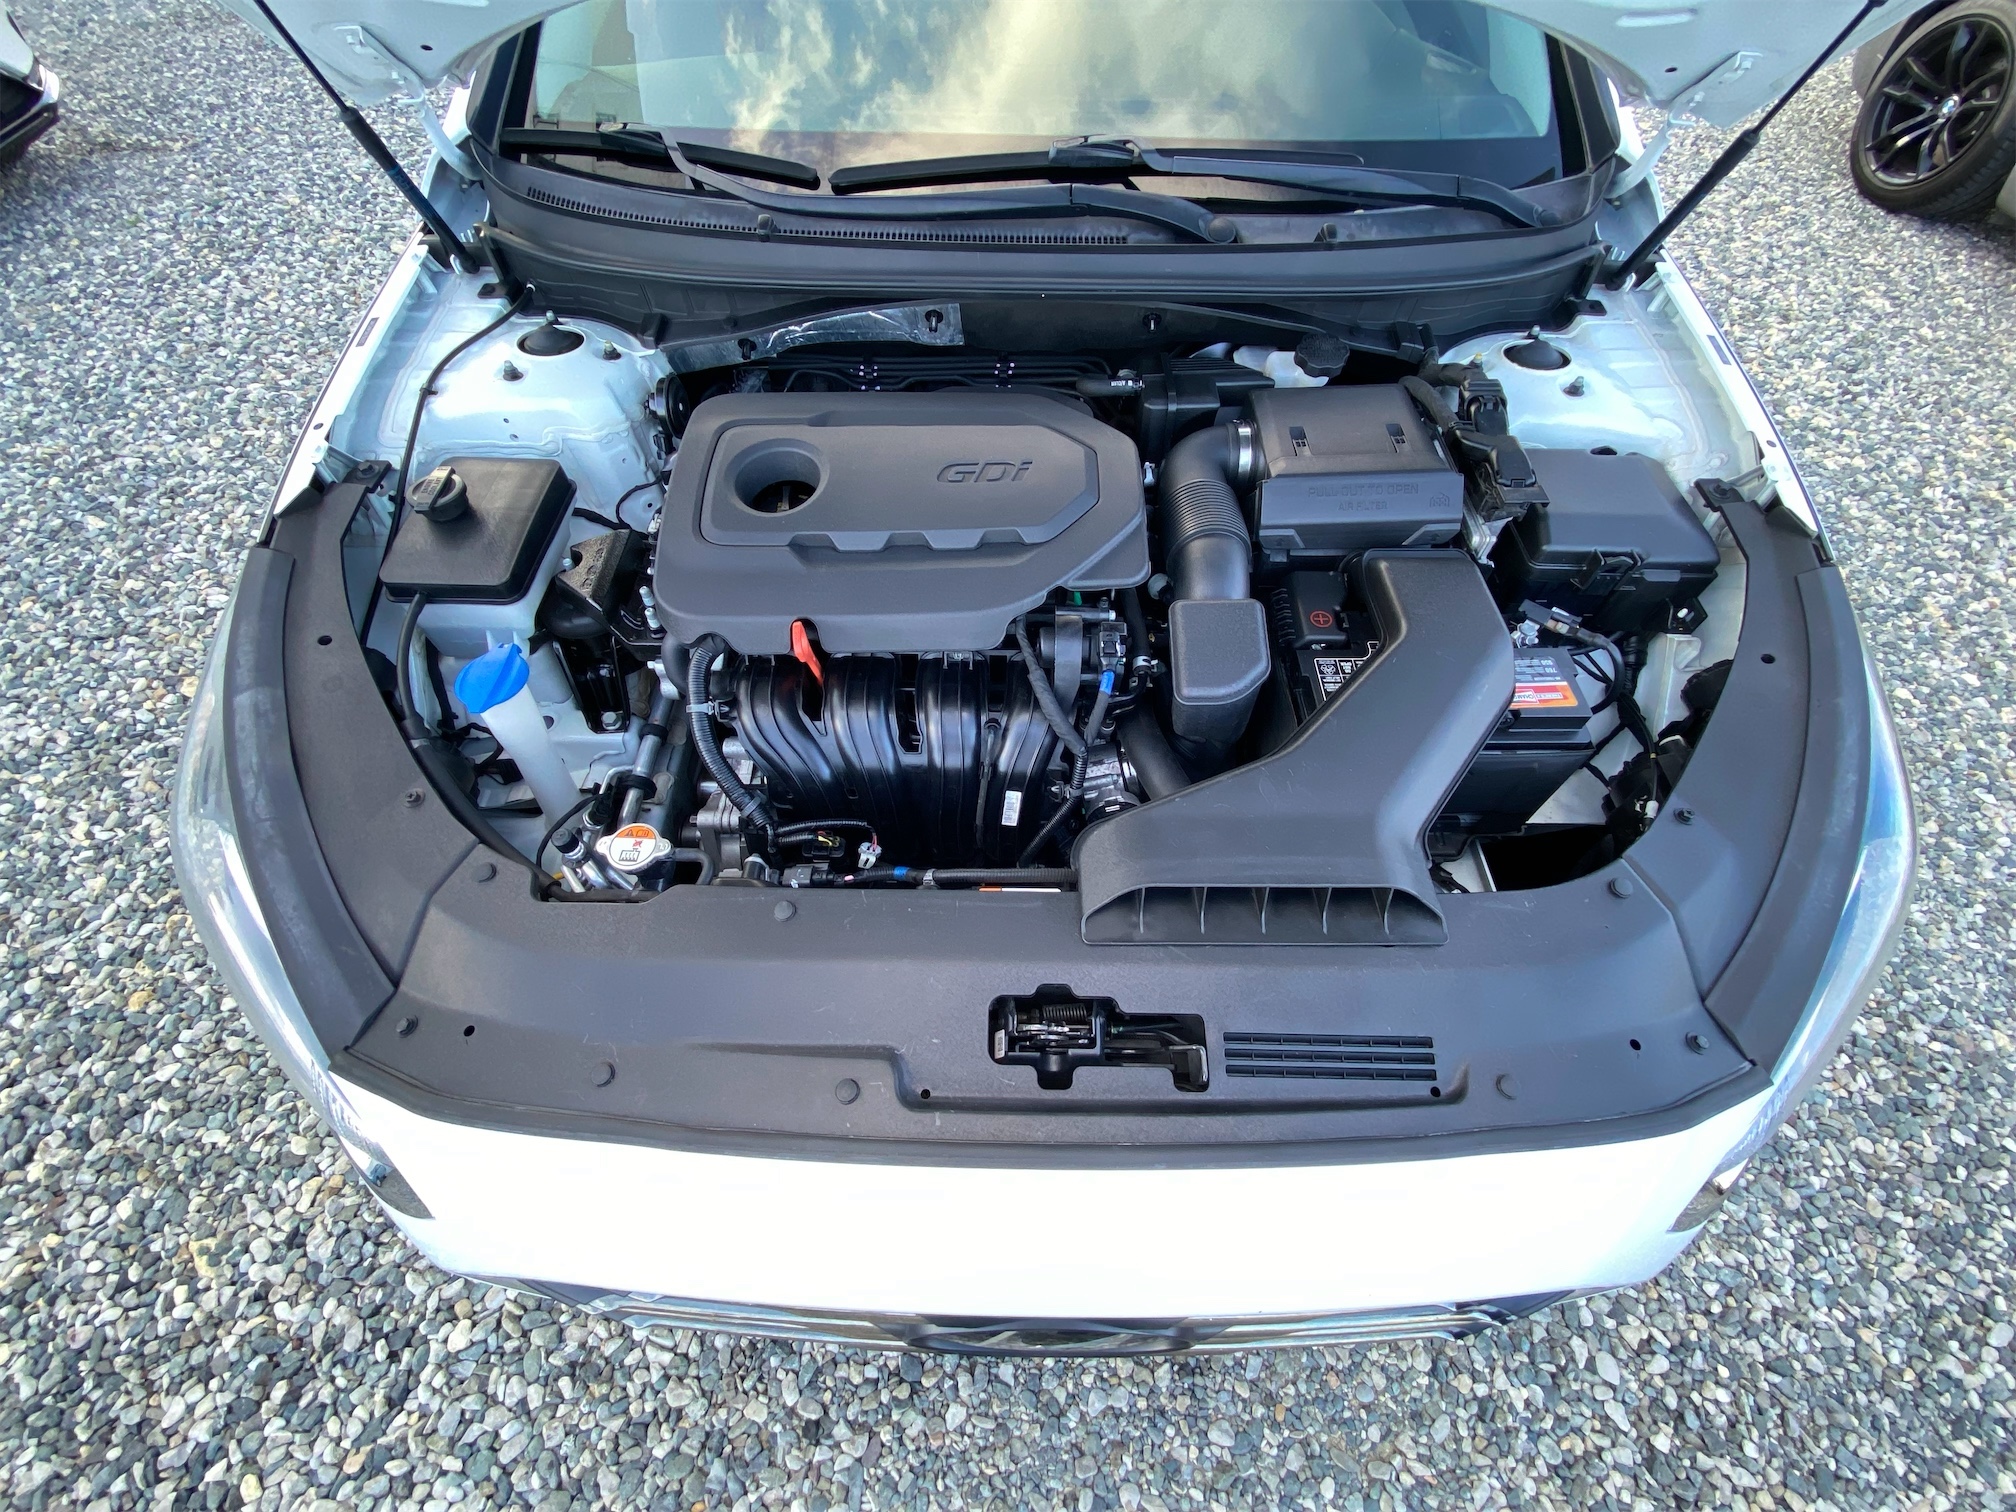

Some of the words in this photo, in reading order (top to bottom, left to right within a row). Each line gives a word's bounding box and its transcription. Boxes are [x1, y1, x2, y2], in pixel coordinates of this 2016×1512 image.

[1386, 482, 1419, 495] OPEN
[1337, 501, 1353, 511] AIR
[1356, 499, 1388, 511] FILTER
